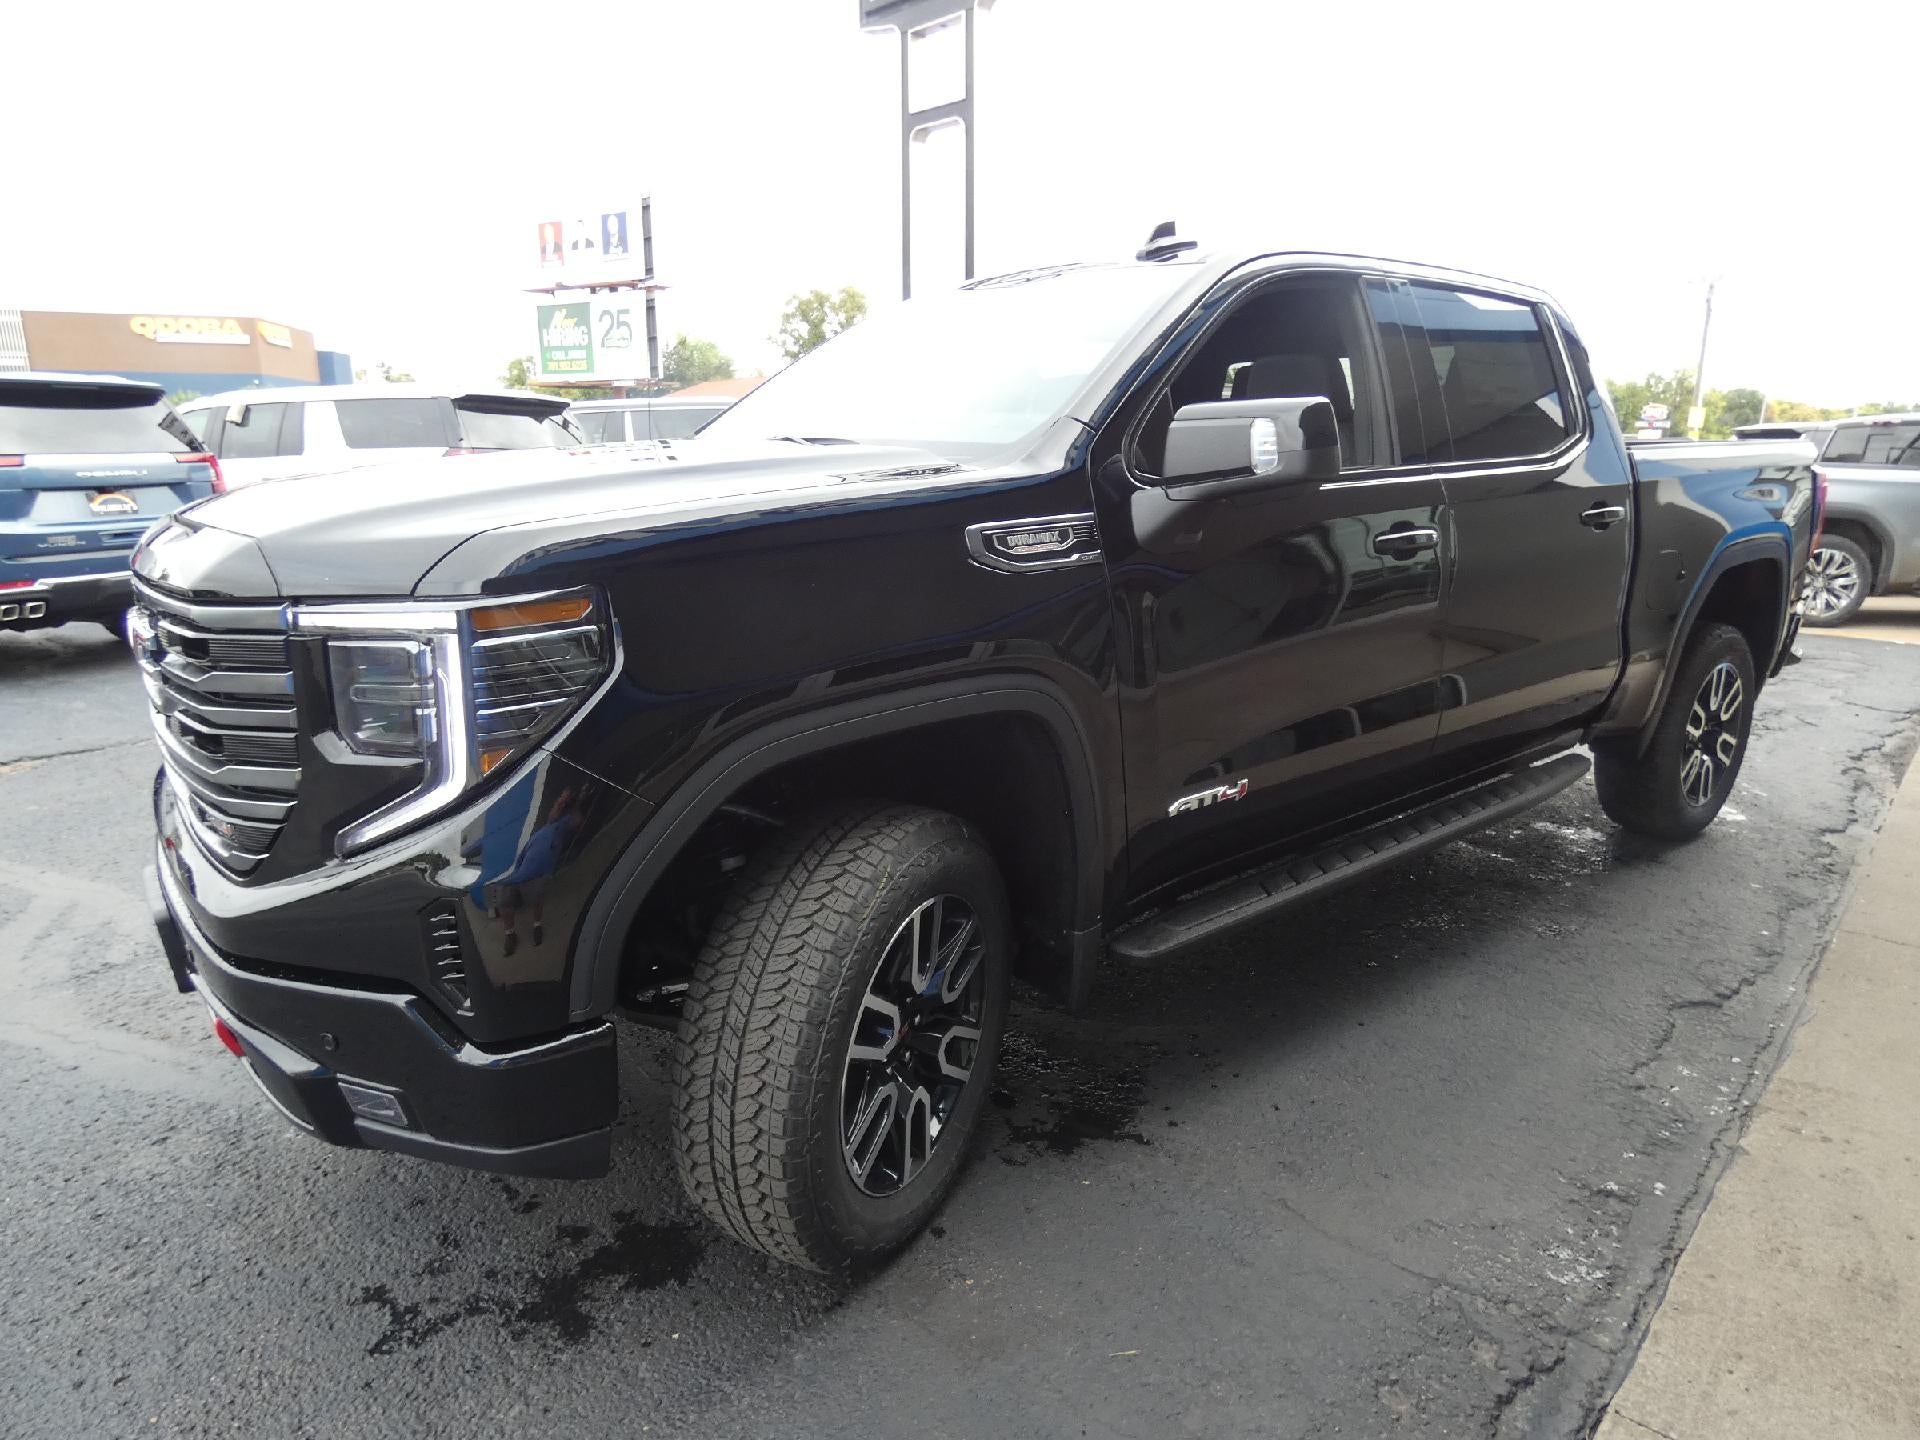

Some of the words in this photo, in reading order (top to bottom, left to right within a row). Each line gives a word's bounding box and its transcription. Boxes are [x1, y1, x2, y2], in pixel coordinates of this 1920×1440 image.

[129, 315, 242, 339] QDOBA
[543, 326, 588, 347] HIRING
[1006, 530, 1062, 547] DURAMAX
[1167, 778, 1249, 818] AT4
